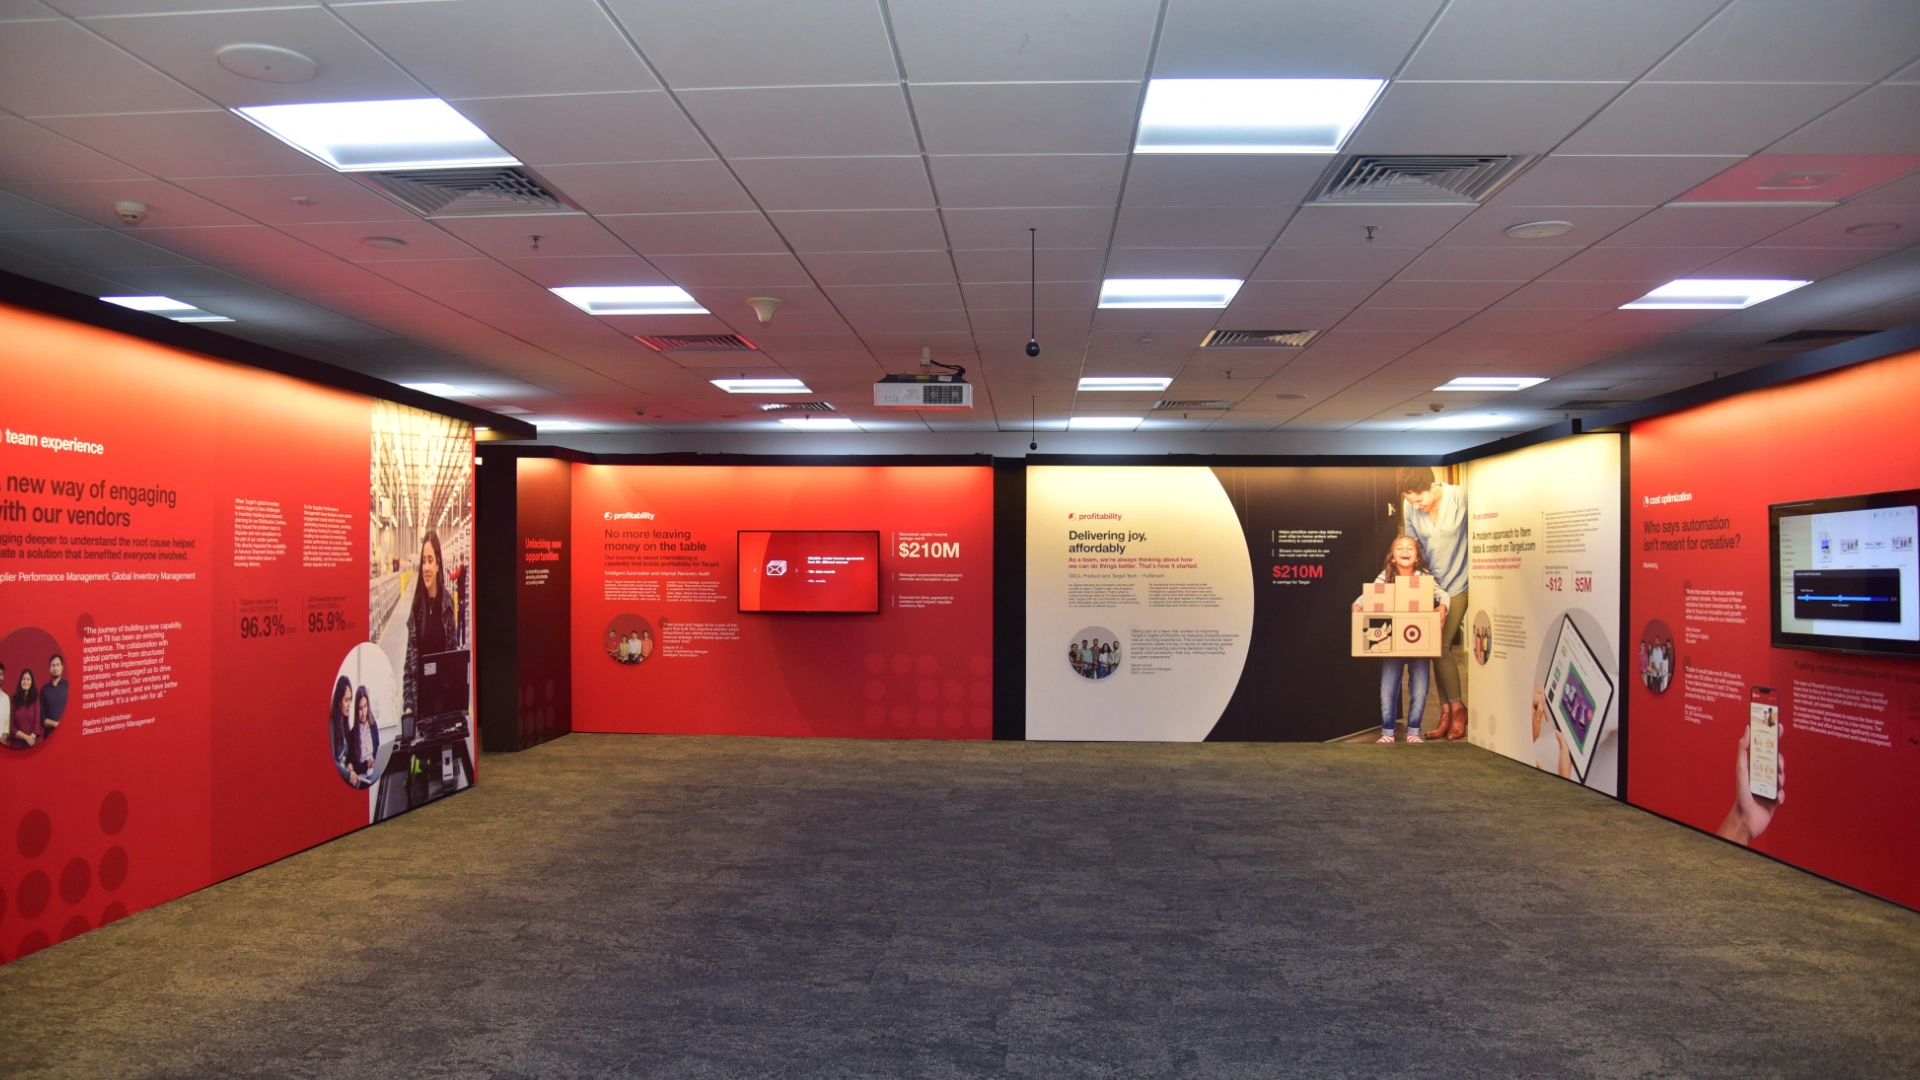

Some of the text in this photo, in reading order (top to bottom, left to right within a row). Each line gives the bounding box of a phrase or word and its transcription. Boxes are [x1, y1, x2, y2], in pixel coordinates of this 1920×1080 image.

[5, 428, 104, 454] team experience
[7, 476, 177, 507] new way of engaging
[1650, 492, 1692, 506] cost optimization
[32, 506, 62, 524] our
[66, 505, 130, 527] vendors
[614, 512, 655, 520] profitability
[1079, 513, 1122, 521] profitability
[1644, 517, 1730, 536] Who says automation
[604, 529, 620, 539] No
[652, 530, 691, 541] leaving
[1069, 531, 1147, 542] Delivering joy,
[1476, 531, 1492, 540] modern
[1492, 529, 1513, 541] approach
[25, 534, 57, 548] deeper
[59, 535, 68, 545] to
[70, 535, 117, 546] understand
[119, 537, 130, 546] the
[132, 537, 148, 547] root
[172, 538, 195, 550] helped
[525, 538, 550, 551] Unlocking
[604, 544, 640, 553] money
[659, 542, 677, 551] the
[679, 542, 706, 551] table
[1472, 545, 1481, 553] data
[1486, 543, 1502, 553] content
[1509, 542, 1536, 553] Target.com
[1644, 534, 1740, 552] isn't meant for creative?
[26, 549, 63, 559] solution
[65, 550, 82, 559] that
[84, 550, 121, 559] benefited
[122, 553, 157, 562] everyone
[158, 552, 188, 560] involved.
[899, 542, 959, 558] $210M
[1068, 543, 1126, 555] affordably
[525, 551, 559, 563] opportunities
[18, 571, 64, 581] Performance
[66, 572, 110, 583] Management,
[112, 572, 131, 580] Global
[133, 572, 159, 582] Inventory
[160, 572, 196, 582] Management
[1272, 565, 1323, 578] $210M
[1575, 577, 1592, 592] $5M
[240, 614, 285, 639] 96.3%
[308, 611, 346, 633] 95.9%
